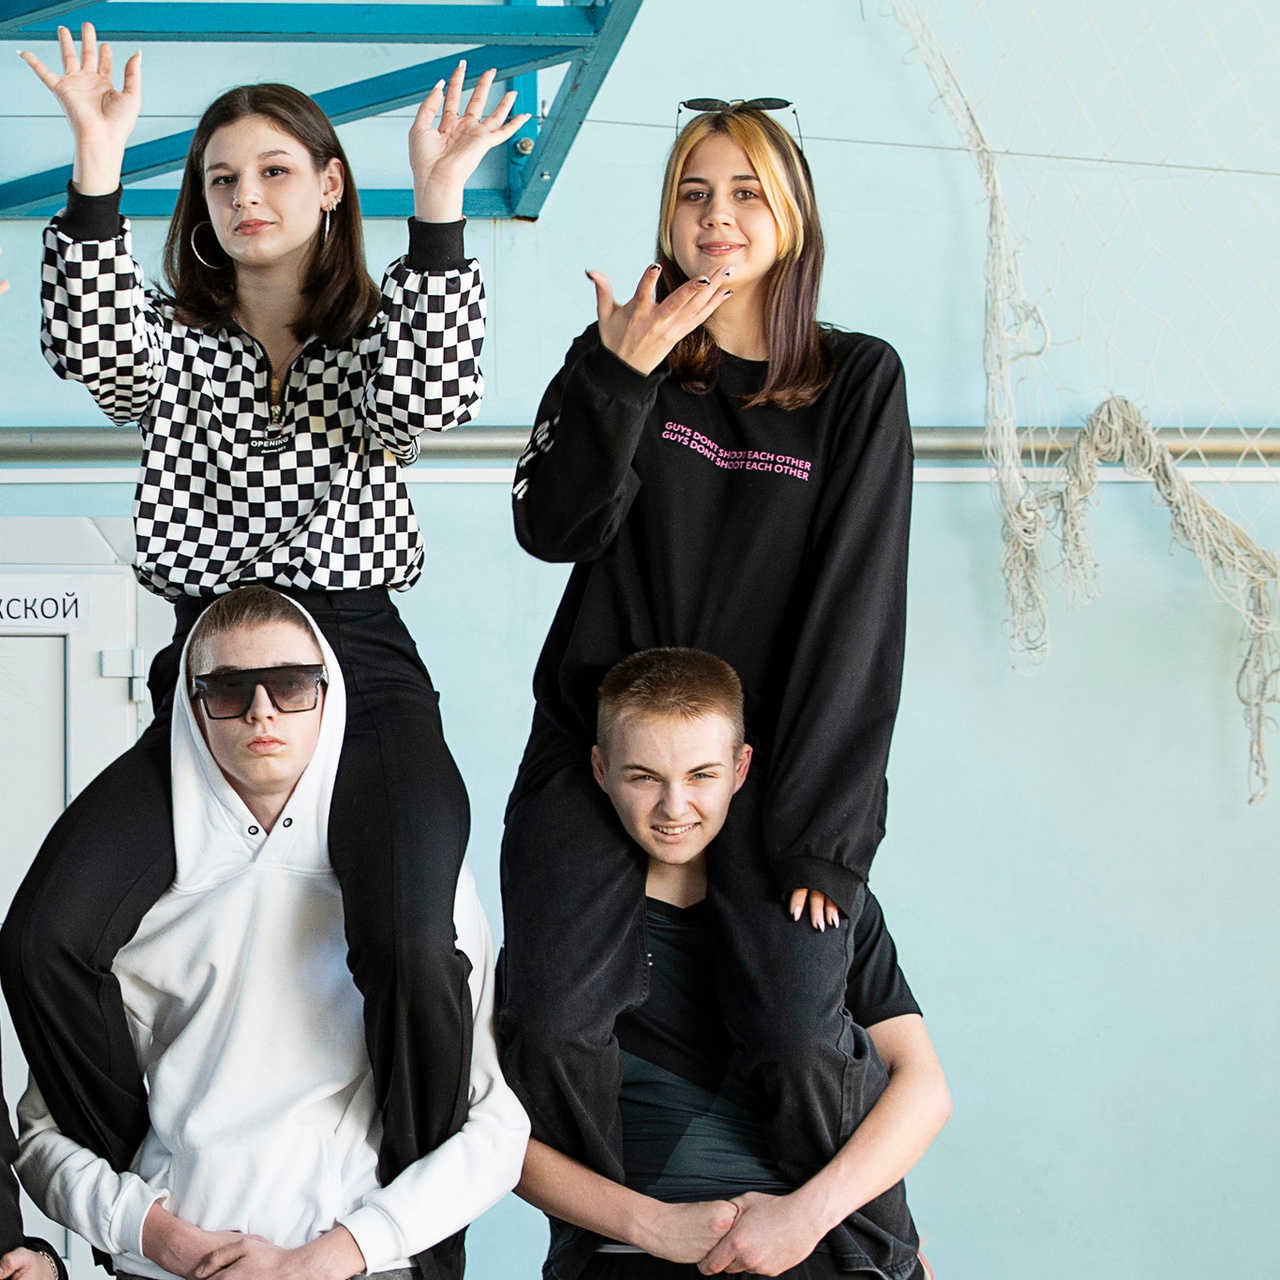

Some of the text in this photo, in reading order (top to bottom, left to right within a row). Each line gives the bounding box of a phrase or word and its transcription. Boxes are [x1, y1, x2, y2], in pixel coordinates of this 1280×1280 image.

[661, 430, 810, 481] GUYS DONT SHOOT EACH OTHER
[664, 421, 812, 471] GUYS DONT SHOOT EACH OTHER
